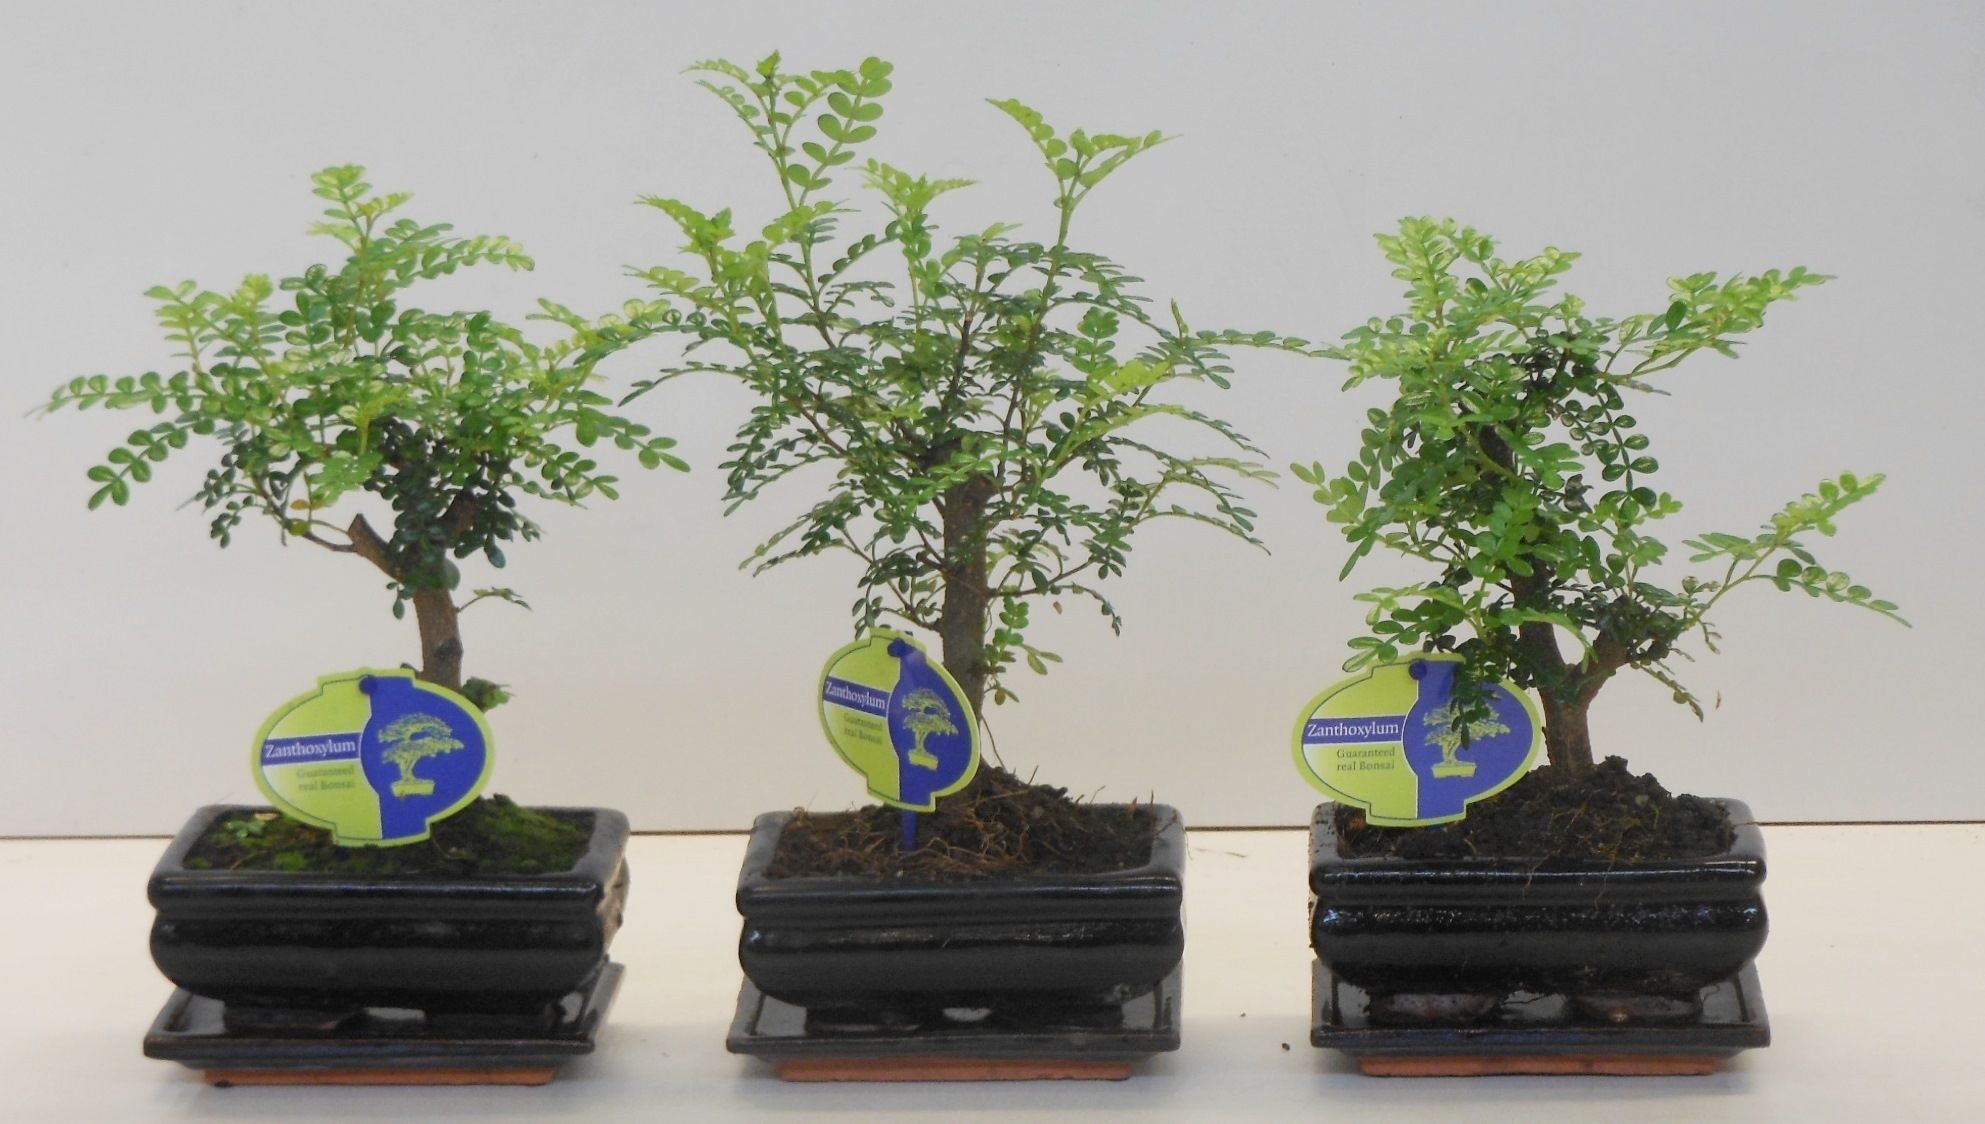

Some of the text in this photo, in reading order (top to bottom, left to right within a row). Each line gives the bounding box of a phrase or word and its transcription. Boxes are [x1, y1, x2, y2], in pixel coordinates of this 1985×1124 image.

[825, 681, 886, 710] Zanthoxylum
[1307, 721, 1399, 738] Zanthoxylum
[265, 739, 356, 758] Zanthoxylum
[1336, 747, 1395, 758] Guaranteed
[1336, 760, 1395, 771] real Bonsai
